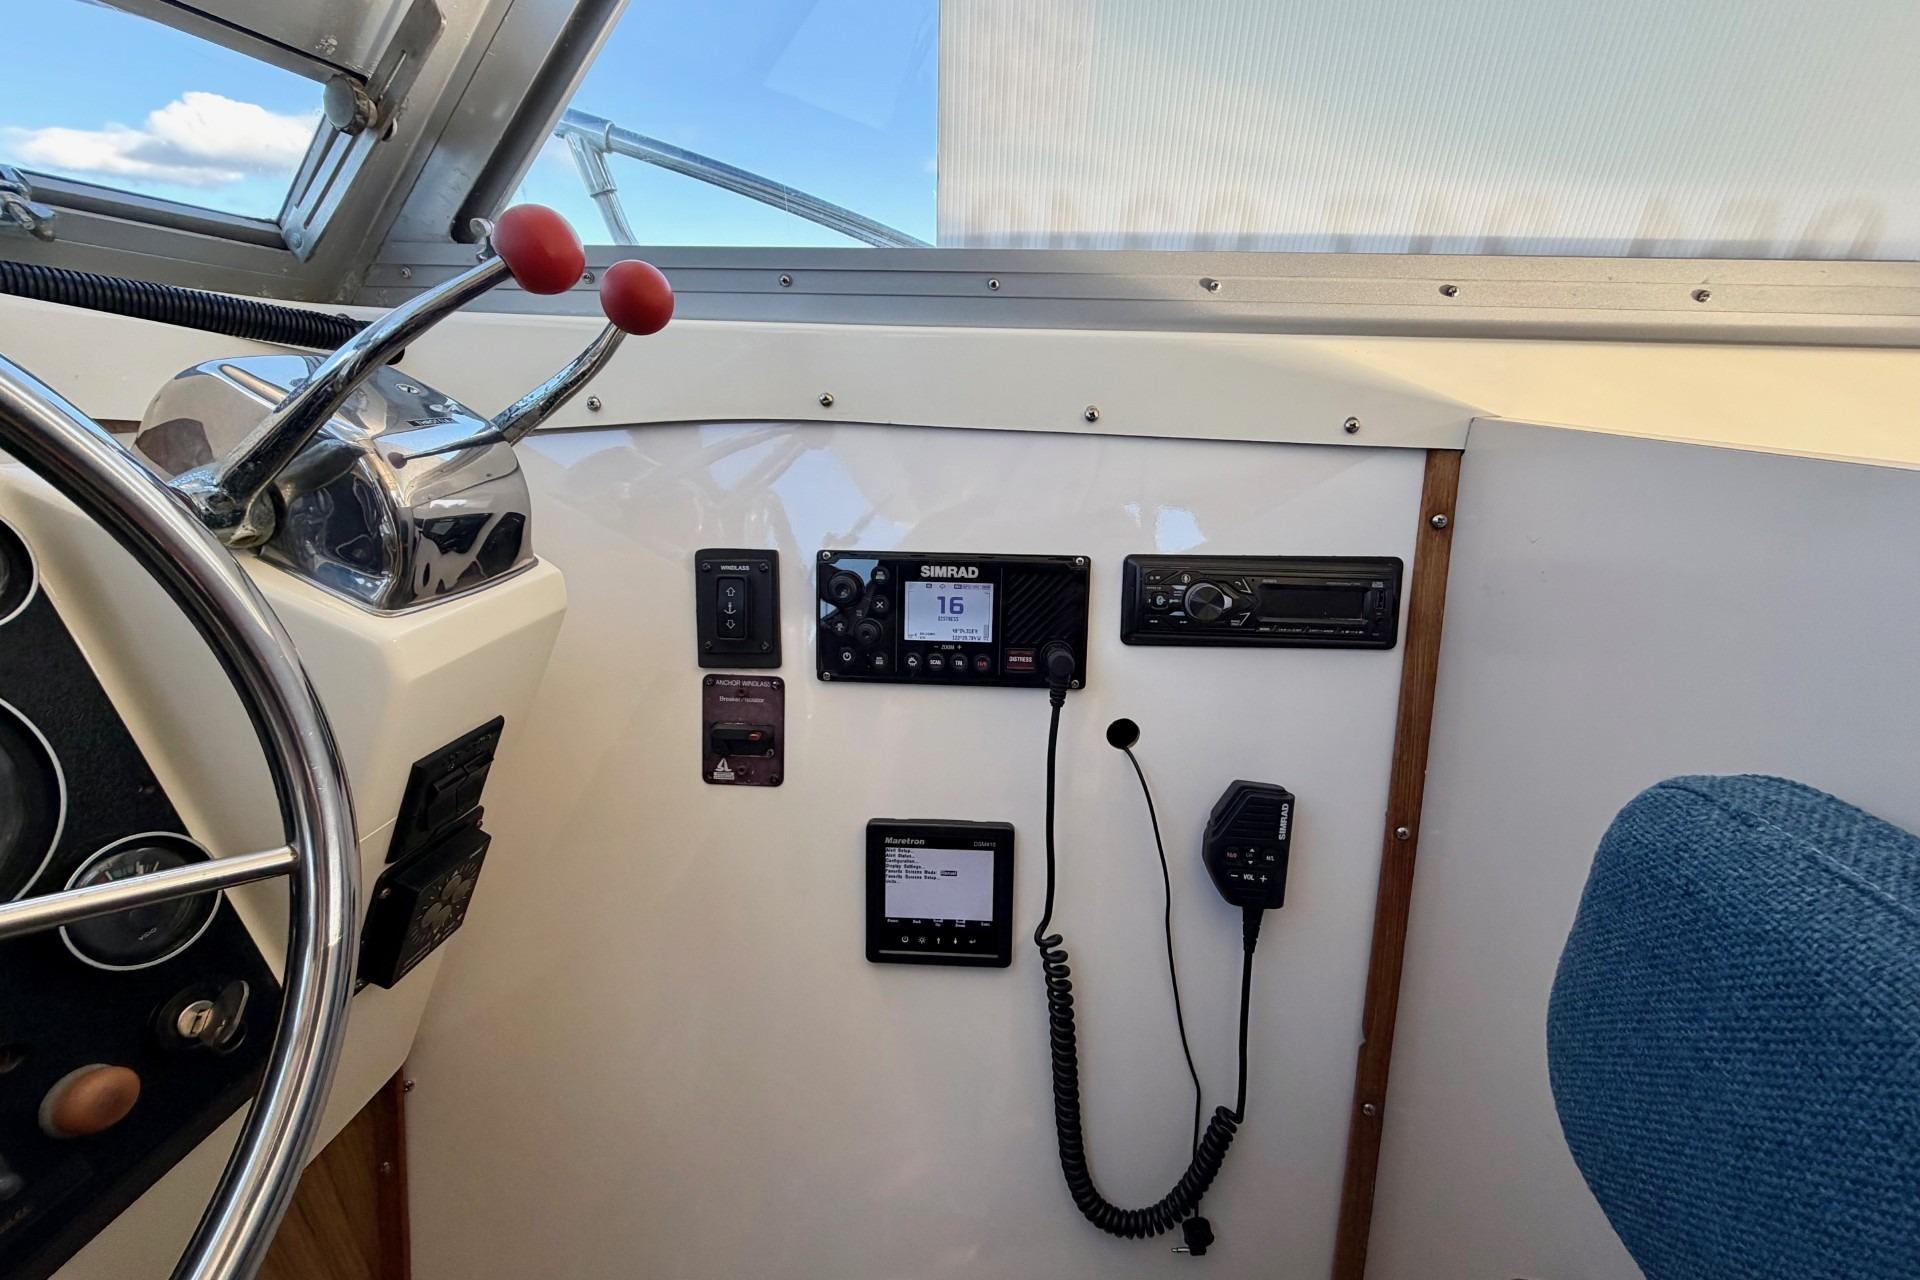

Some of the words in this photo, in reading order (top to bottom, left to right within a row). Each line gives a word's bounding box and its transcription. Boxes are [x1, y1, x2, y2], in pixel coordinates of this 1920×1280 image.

[920, 565, 979, 579] SIMRAD
[937, 596, 964, 615] 16
[715, 679, 741, 687] ANCHOR
[1278, 803, 1290, 841] SIMRAD
[884, 836, 926, 846] Maretron
[1243, 873, 1255, 881] VOL
